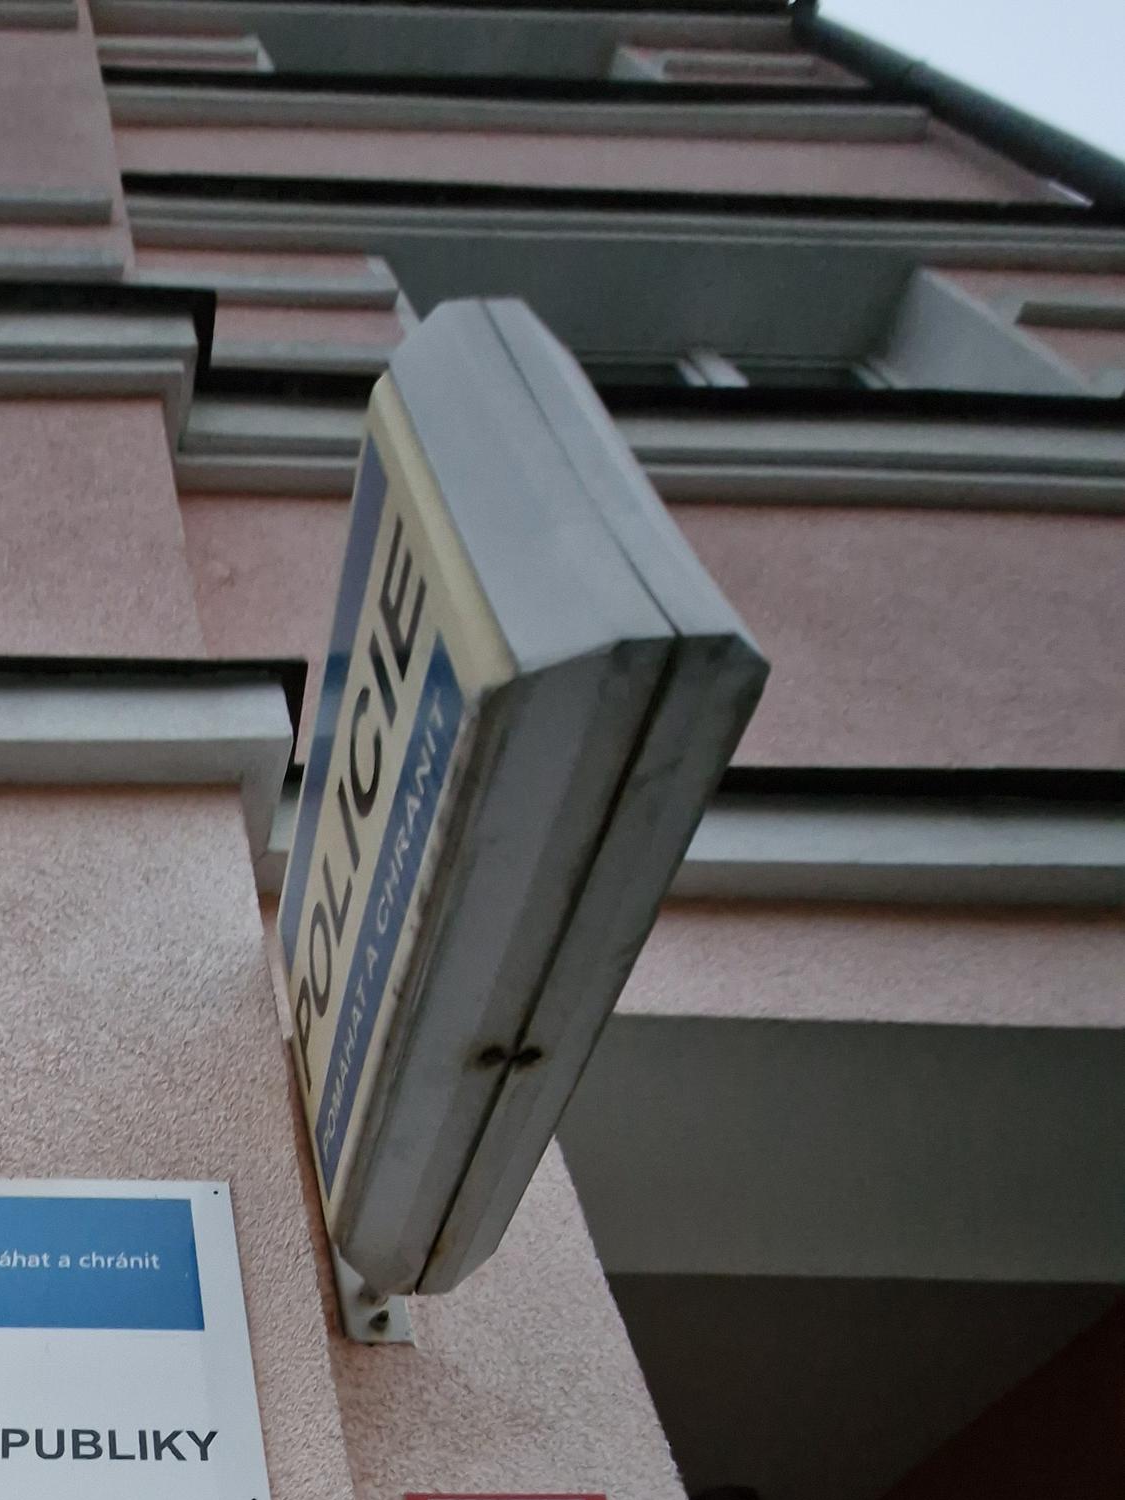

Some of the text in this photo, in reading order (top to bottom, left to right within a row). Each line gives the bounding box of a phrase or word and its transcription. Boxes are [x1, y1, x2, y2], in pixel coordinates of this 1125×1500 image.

[294, 512, 426, 1094] POLICIE
[366, 945, 379, 980] A
[58, 1254, 71, 1269] a
[79, 1251, 161, 1271] chránit
